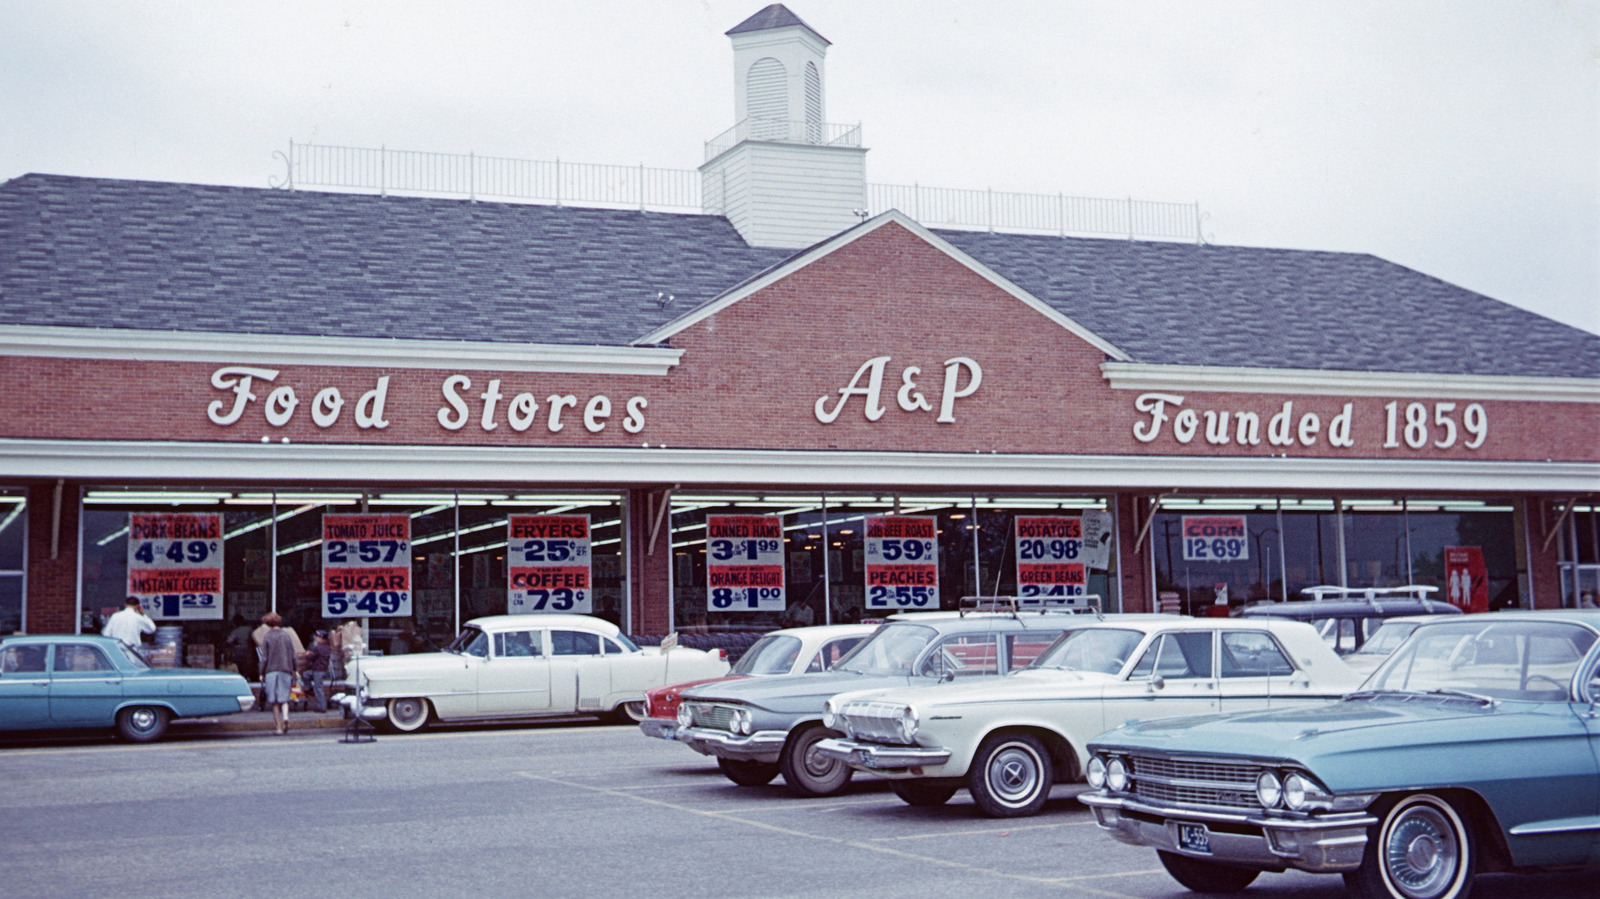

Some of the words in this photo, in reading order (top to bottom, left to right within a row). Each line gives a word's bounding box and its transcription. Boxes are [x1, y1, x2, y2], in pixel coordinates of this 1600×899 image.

[815, 356, 982, 423] A&P
[207, 366, 389, 429] Food
[437, 374, 648, 433] Stores
[1132, 392, 1354, 446] Founded
[1383, 400, 1488, 449] 1859
[133, 523, 167, 539] PORK
[174, 523, 217, 539] BEANS
[327, 525, 367, 538] TOMATO
[370, 524, 403, 538] JUICE
[513, 525, 585, 538] FRYERS
[710, 525, 749, 538] CANNED
[753, 525, 779, 537] HAMS
[867, 525, 882, 537] RIB
[884, 525, 902, 537] BEEF
[905, 524, 932, 538] ROAST
[1020, 525, 1079, 537] POTATOES
[1187, 525, 1244, 537] CORN
[135, 542, 154, 563] 4
[166, 541, 217, 563] 49¢
[327, 541, 348, 563] 2
[359, 540, 407, 563] 57¢
[524, 540, 576, 561] 25¢
[711, 540, 733, 560] 3
[882, 539, 932, 560] 59¢
[1020, 540, 1045, 559] 20
[1187, 539, 1207, 558] 12
[133, 578, 178, 592] INSTANT
[183, 577, 217, 592] COFFEE
[328, 576, 404, 590] SUGAR
[513, 573, 584, 587] COFFEE
[710, 573, 747, 585] ORANGE
[749, 572, 780, 585] DELIGHT
[870, 571, 934, 584] PEACHES
[1020, 571, 1052, 582] GREEN
[1054, 571, 1082, 582] BEANS
[327, 592, 348, 614] 5
[355, 591, 408, 613] 49¢
[527, 588, 585, 610] 73¢
[712, 588, 733, 608] 8
[870, 585, 887, 606] 2
[895, 586, 934, 606] 55¢
[1022, 584, 1040, 604] 2
